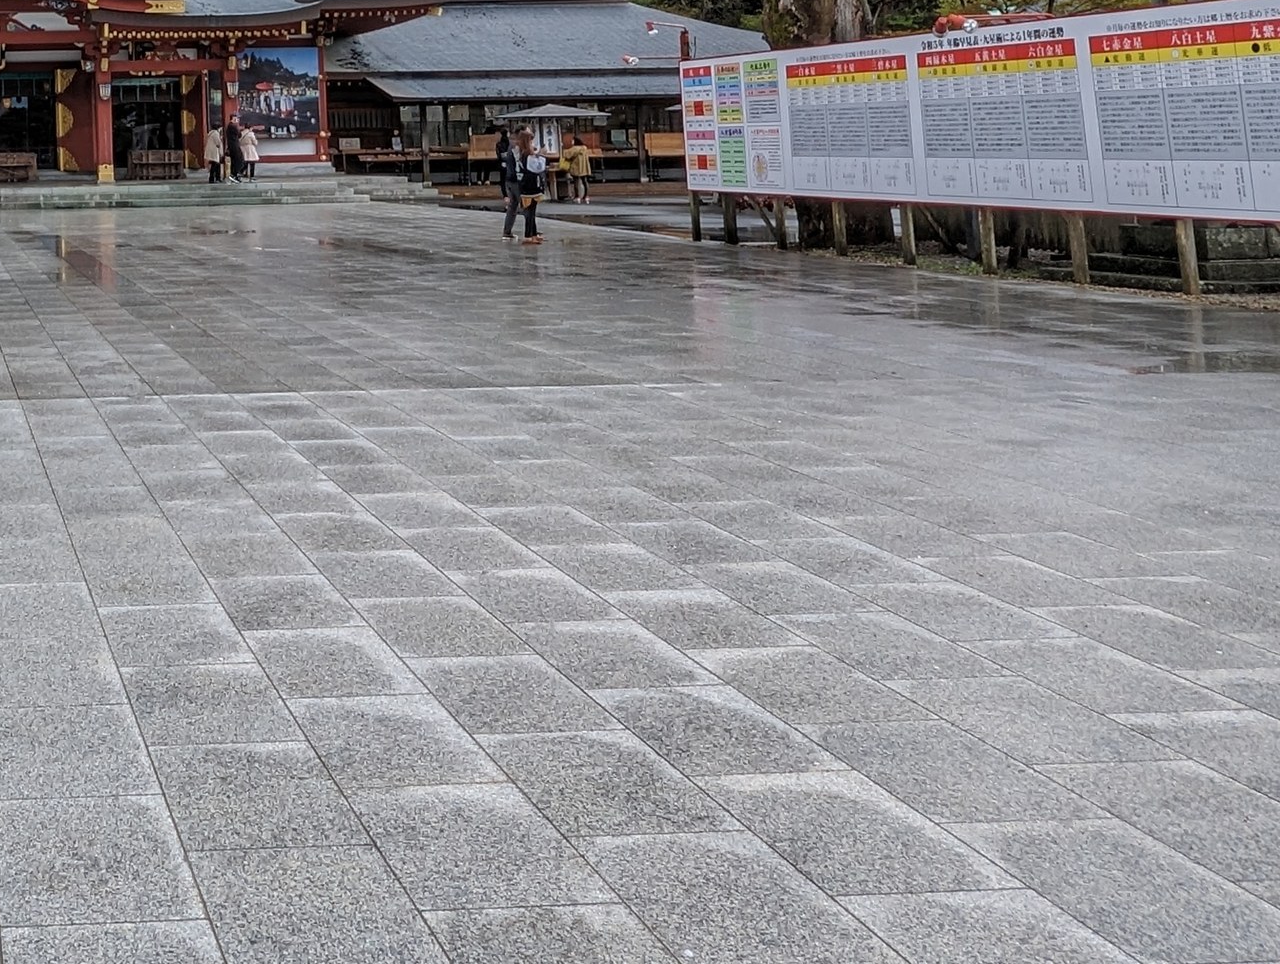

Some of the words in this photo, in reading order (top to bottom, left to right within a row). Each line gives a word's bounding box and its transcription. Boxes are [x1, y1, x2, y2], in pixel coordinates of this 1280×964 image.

[1101, 35, 1143, 51] 七赤金星
[1170, 30, 1217, 46] 八白土星
[920, 40, 944, 52] 令和5年
[1028, 44, 1064, 57] 六白金星
[974, 49, 1007, 62] 五黄土星
